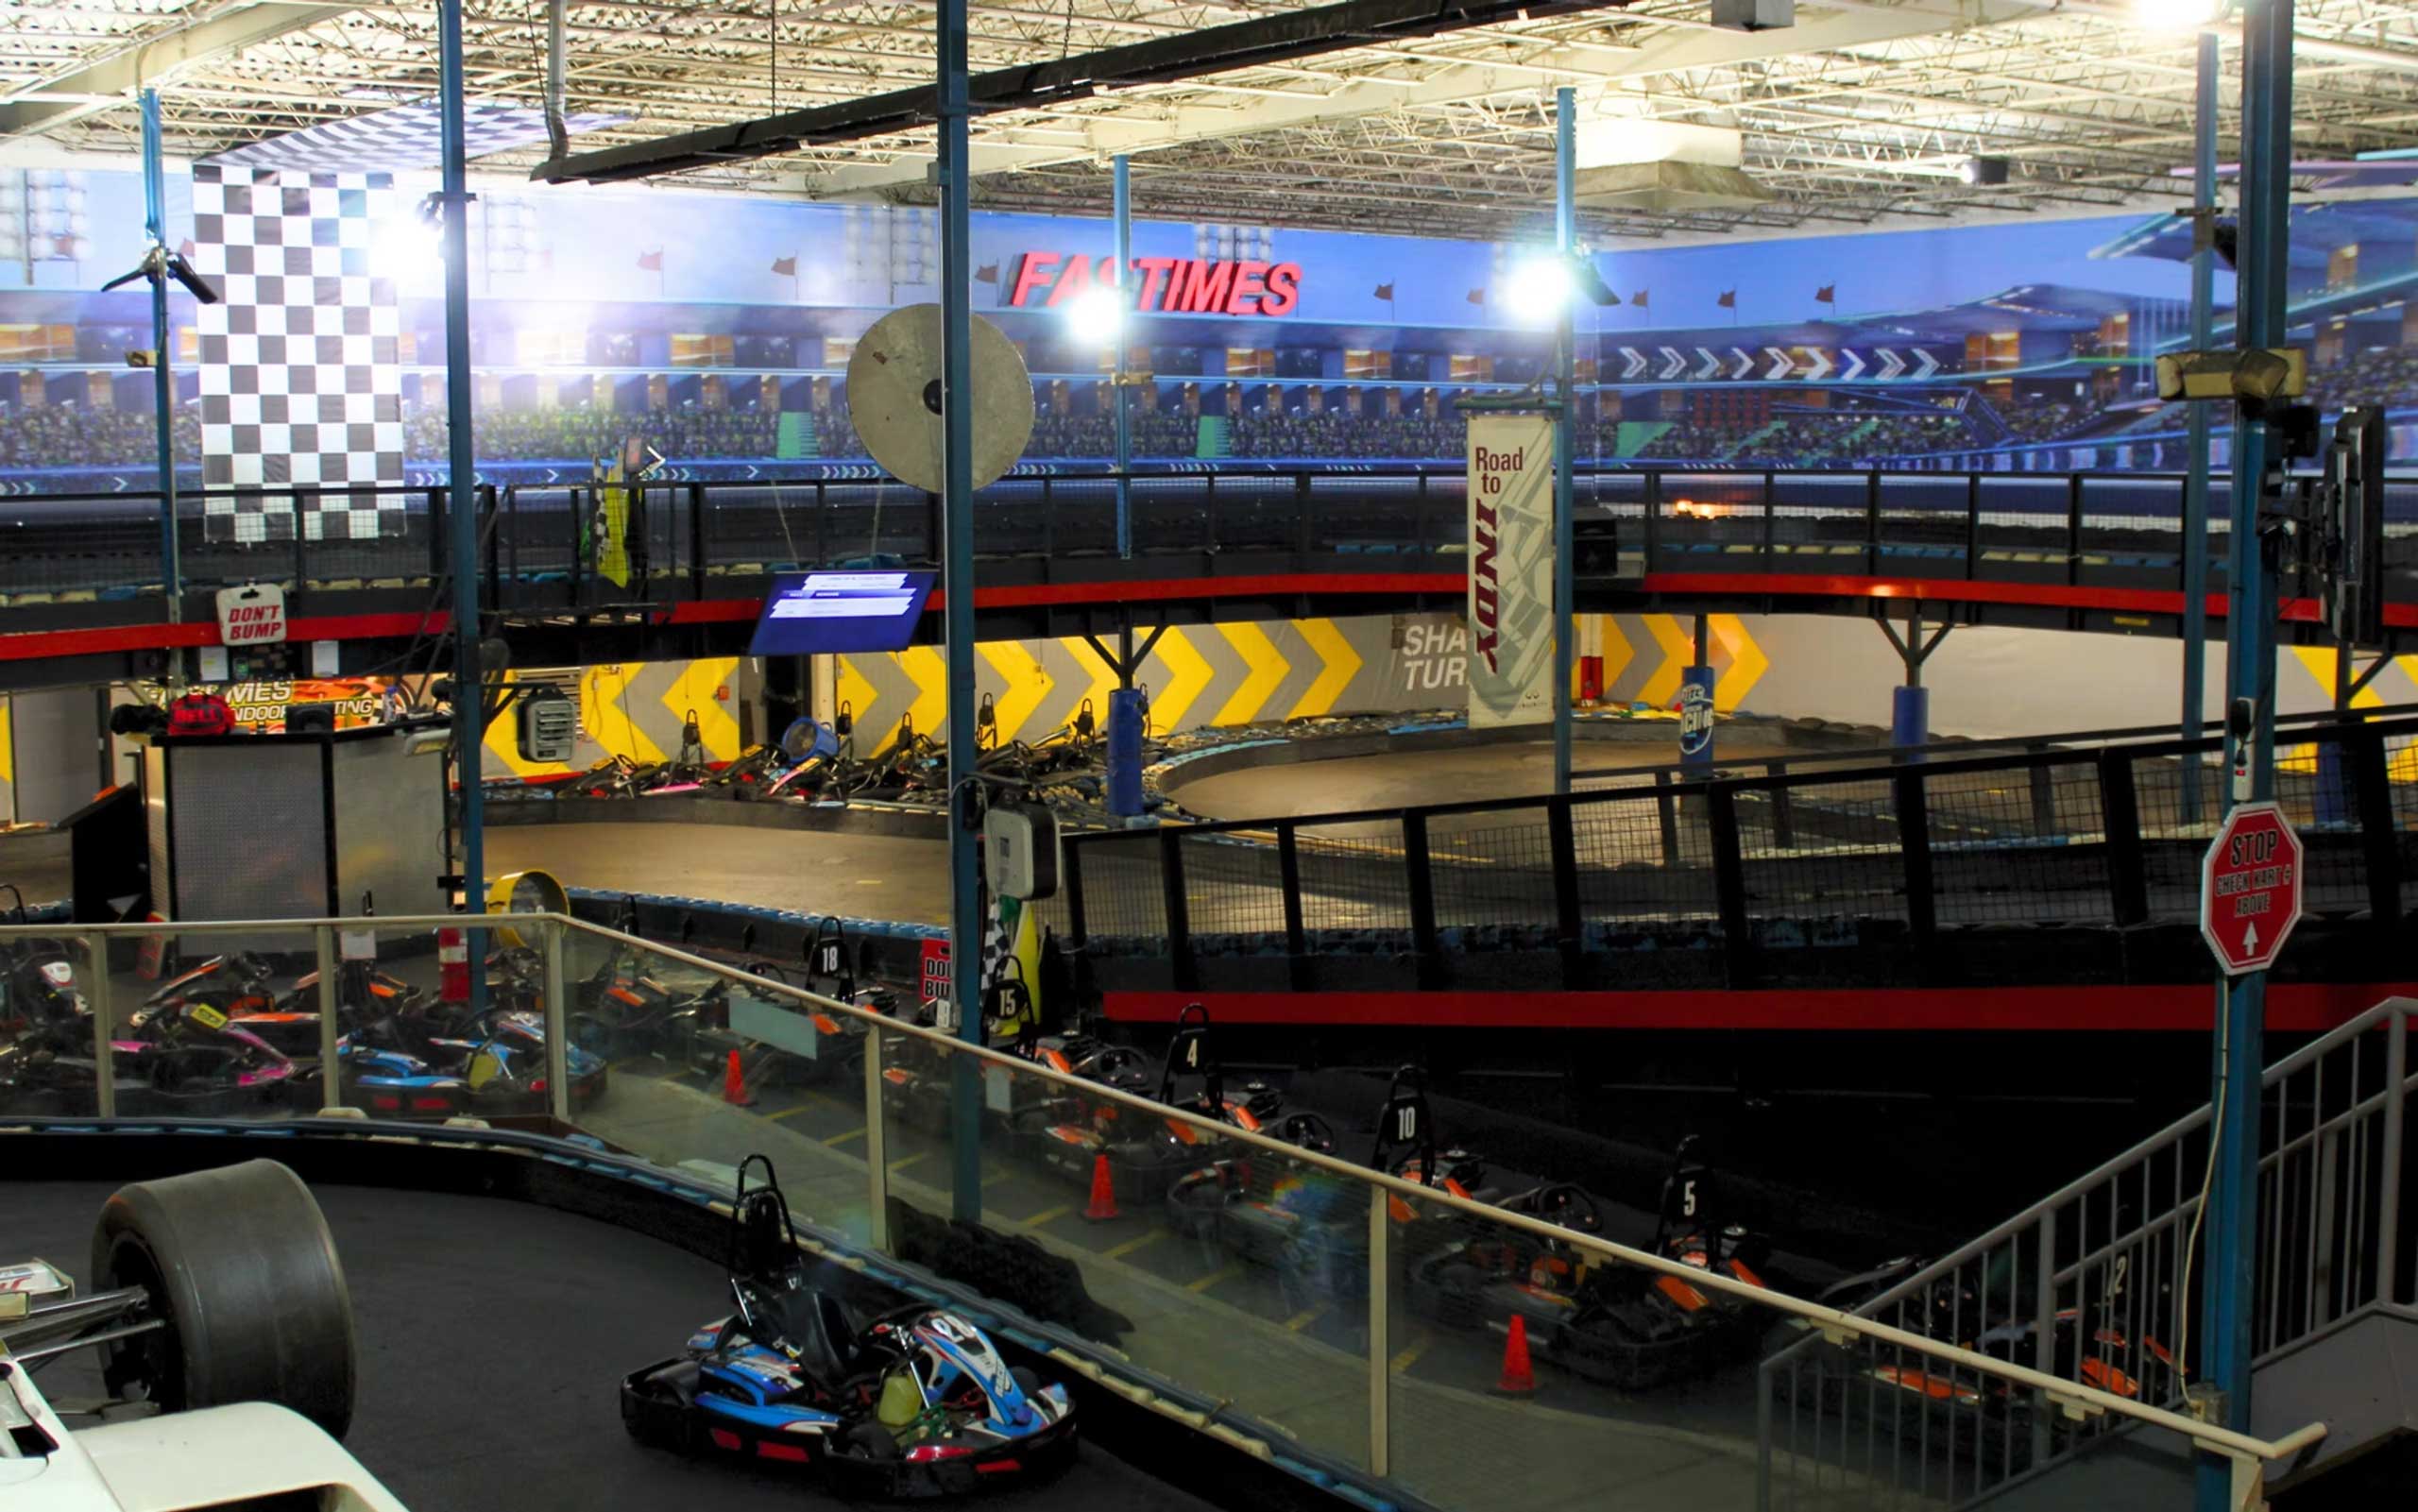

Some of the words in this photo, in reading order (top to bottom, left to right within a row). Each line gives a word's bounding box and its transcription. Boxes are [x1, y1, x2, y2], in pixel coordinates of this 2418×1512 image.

[1474, 447, 1524, 472] Road
[1481, 473, 1501, 494] to
[1473, 498, 1498, 675] INDY
[229, 604, 281, 623] DON'T
[230, 622, 281, 640] BUMP
[1403, 623, 1467, 656] SHA
[1404, 656, 1468, 690] TUR
[333, 698, 374, 716] TING
[2231, 829, 2278, 867] STOP
[2215, 870, 2251, 896] CHECK
[2253, 865, 2282, 891] KART
[2234, 892, 2273, 918] ABOVE
[822, 945, 839, 974] 18
[998, 989, 1016, 1017] 15
[1186, 1038, 1198, 1068] 4
[1398, 1106, 1416, 1141] 10
[1683, 1181, 1696, 1216] 5
[931, 1314, 976, 1344] 20
